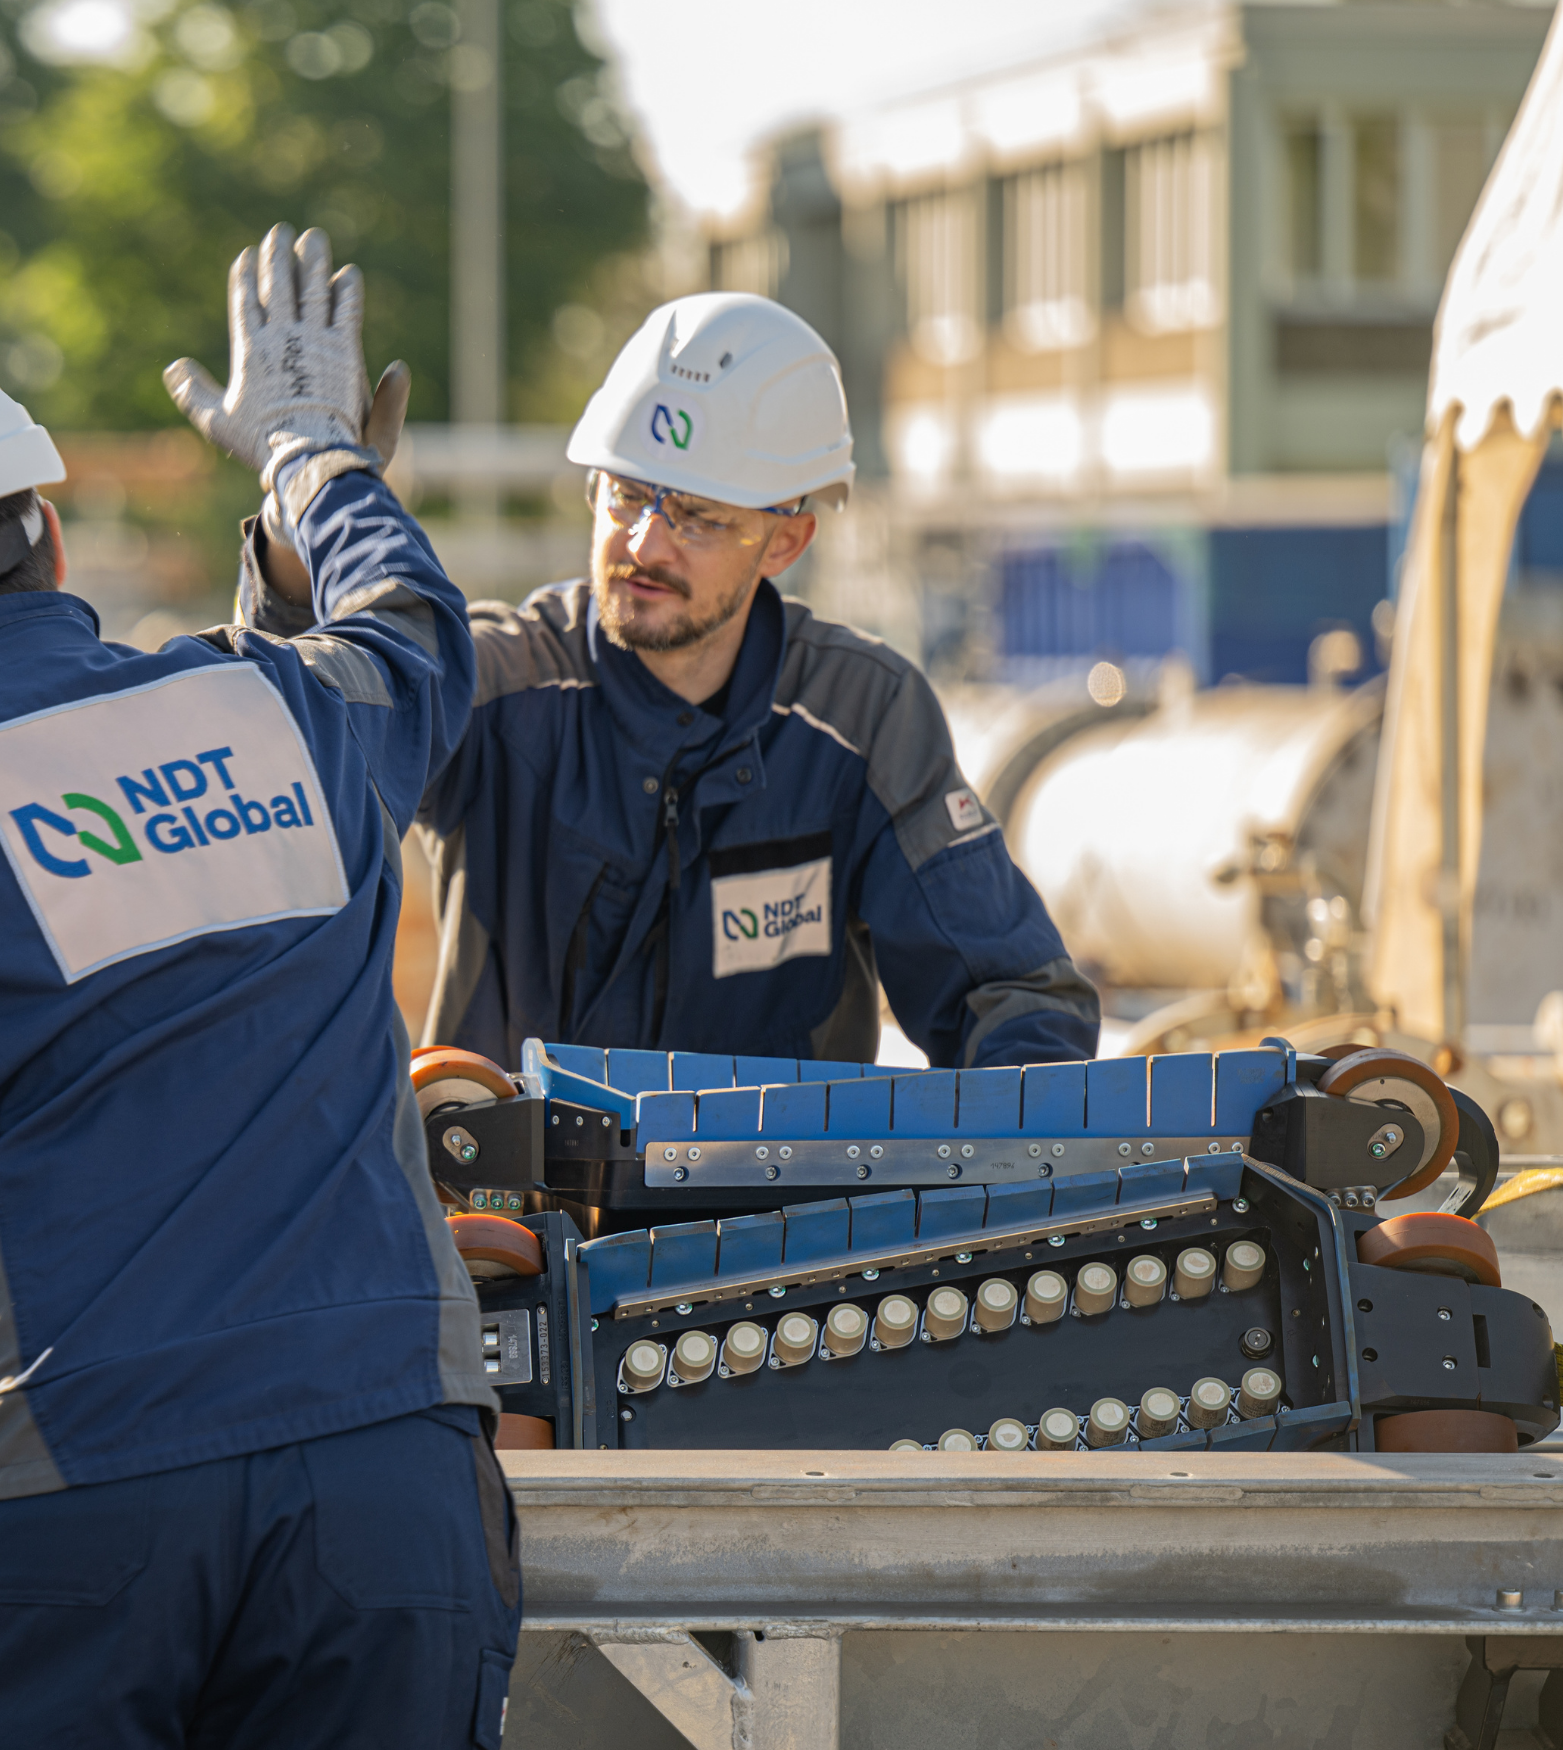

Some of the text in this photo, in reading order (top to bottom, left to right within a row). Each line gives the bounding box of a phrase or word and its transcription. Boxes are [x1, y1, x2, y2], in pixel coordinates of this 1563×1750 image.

[116, 746, 236, 814] NDT
[143, 782, 314, 853] Global
[764, 893, 805, 920] NDT
[764, 905, 821, 937] Global
[539, 1321, 549, 1377] 153373-022
